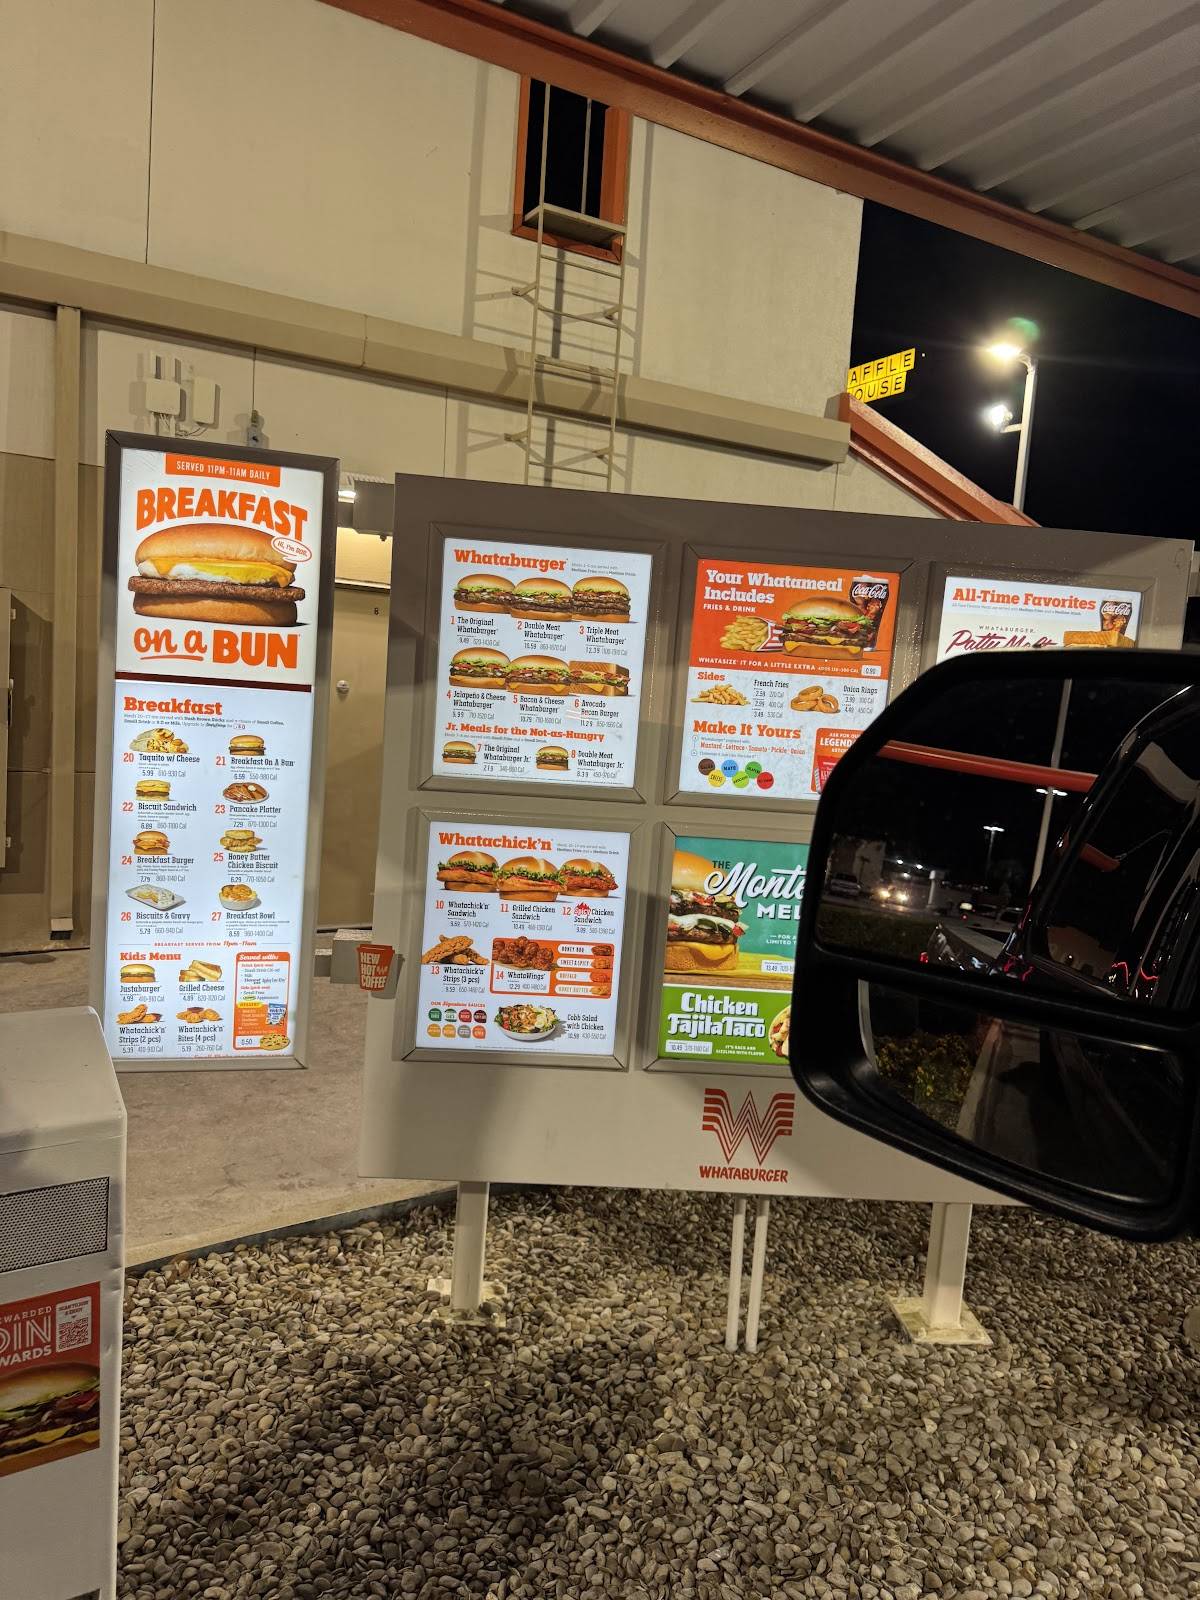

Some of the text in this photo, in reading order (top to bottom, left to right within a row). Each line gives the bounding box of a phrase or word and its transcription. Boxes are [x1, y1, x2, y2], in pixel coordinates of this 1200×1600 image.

[850, 353, 911, 385] AFFLE
[855, 376, 902, 400] OUSE
[176, 461, 271, 480] SERVED 11PM-11AM DAILY
[136, 487, 308, 541] BREAKFAST
[454, 549, 566, 572] Whataburger
[707, 569, 843, 591] Your Whatameal
[703, 586, 775, 604] Includes
[952, 588, 1020, 605] All-Time
[1023, 592, 1096, 610] Favorites
[703, 603, 723, 611] FRIES
[732, 605, 756, 613] DRINK
[457, 616, 494, 627] The Original
[517, 621, 561, 631] 2 Double Meat
[457, 625, 497, 635] Whataburger
[579, 626, 619, 636] 3 Triple Meat
[978, 625, 1035, 633] WHATABURGER
[524, 630, 563, 640] Whataburger
[585, 634, 625, 645] Whataburger
[945, 629, 1006, 654] Patty
[134, 627, 298, 669] on a BUN
[699, 657, 736, 665] WHATASIZE
[793, 663, 816, 671] EXTRA
[697, 671, 726, 681] Sides
[754, 679, 774, 688] French
[843, 685, 878, 695] Onion Rings
[446, 690, 451, 699] 4
[486, 693, 506, 701] Cheese
[513, 695, 565, 705] 5 Bacon Cheese
[124, 696, 223, 715] Breakfast
[453, 700, 492, 709] Whataburger
[574, 699, 605, 708] 6 Avocado
[519, 704, 558, 714] Whataburger
[600, 709, 619, 718] Burger
[445, 722, 458, 732] Jr.
[460, 723, 490, 733] Meals
[493, 725, 509, 734] for
[510, 726, 527, 735] the
[529, 727, 605, 743] Not-as-Hungry
[693, 720, 801, 738] Make It Yours
[820, 738, 856, 747] LEGEND
[478, 743, 520, 755] 7 The Original
[123, 752, 200, 763] 20 Taquito w/ Cheese
[483, 752, 522, 763] Whataburger
[570, 750, 613, 760] 8 Double Meat
[215, 756, 226, 766] 21
[231, 756, 263, 765] Breakfast
[264, 758, 273, 766] On
[577, 758, 615, 769] Whataburger
[122, 802, 197, 812] 22 Biscuit Sandwich
[214, 804, 281, 814] 23 Pancake Platter
[438, 832, 553, 851] Whatachick'n
[121, 856, 194, 865] 24 Breakfast Burger
[213, 852, 270, 862] 25 Honey Butter
[228, 861, 279, 869] Chicken Biscuit
[712, 860, 731, 870] THE
[436, 900, 489, 910] 10 Whatachick'n
[500, 904, 555, 914] 11 Grilled Chicken
[121, 912, 191, 921] 26 Biscuits & Gravy
[211, 911, 275, 921] 27 Breakfast Bowl
[447, 910, 477, 918] Sandwich
[511, 912, 541, 921] Sandwich
[562, 907, 615, 917] 12 Chicken
[757, 903, 800, 920] MEL
[574, 915, 602, 924] Sandwich
[120, 951, 182, 961] Kids Menu
[360, 952, 380, 965] NEW
[360, 964, 377, 976] HOT
[431, 965, 484, 976] 13 Whatachick'n
[442, 975, 461, 984] Strips
[495, 970, 544, 981] 14 WhataWings
[361, 975, 387, 988] COFFEE
[120, 985, 160, 994] Justaburger
[179, 984, 225, 992] Grilled Cheese
[681, 992, 758, 1016] Chicken
[120, 1026, 164, 1034] Whatachick'n
[178, 1025, 223, 1034] Whatachick'n
[581, 1023, 604, 1031] Chicken
[667, 1013, 766, 1039] Fajita Taco
[119, 1035, 139, 1044] Strips
[178, 1034, 194, 1042] Bites
[699, 1165, 789, 1183] WHATABURGER
[0, 1306, 52, 1324] WARDED
[0, 1344, 52, 1367] WARDS
